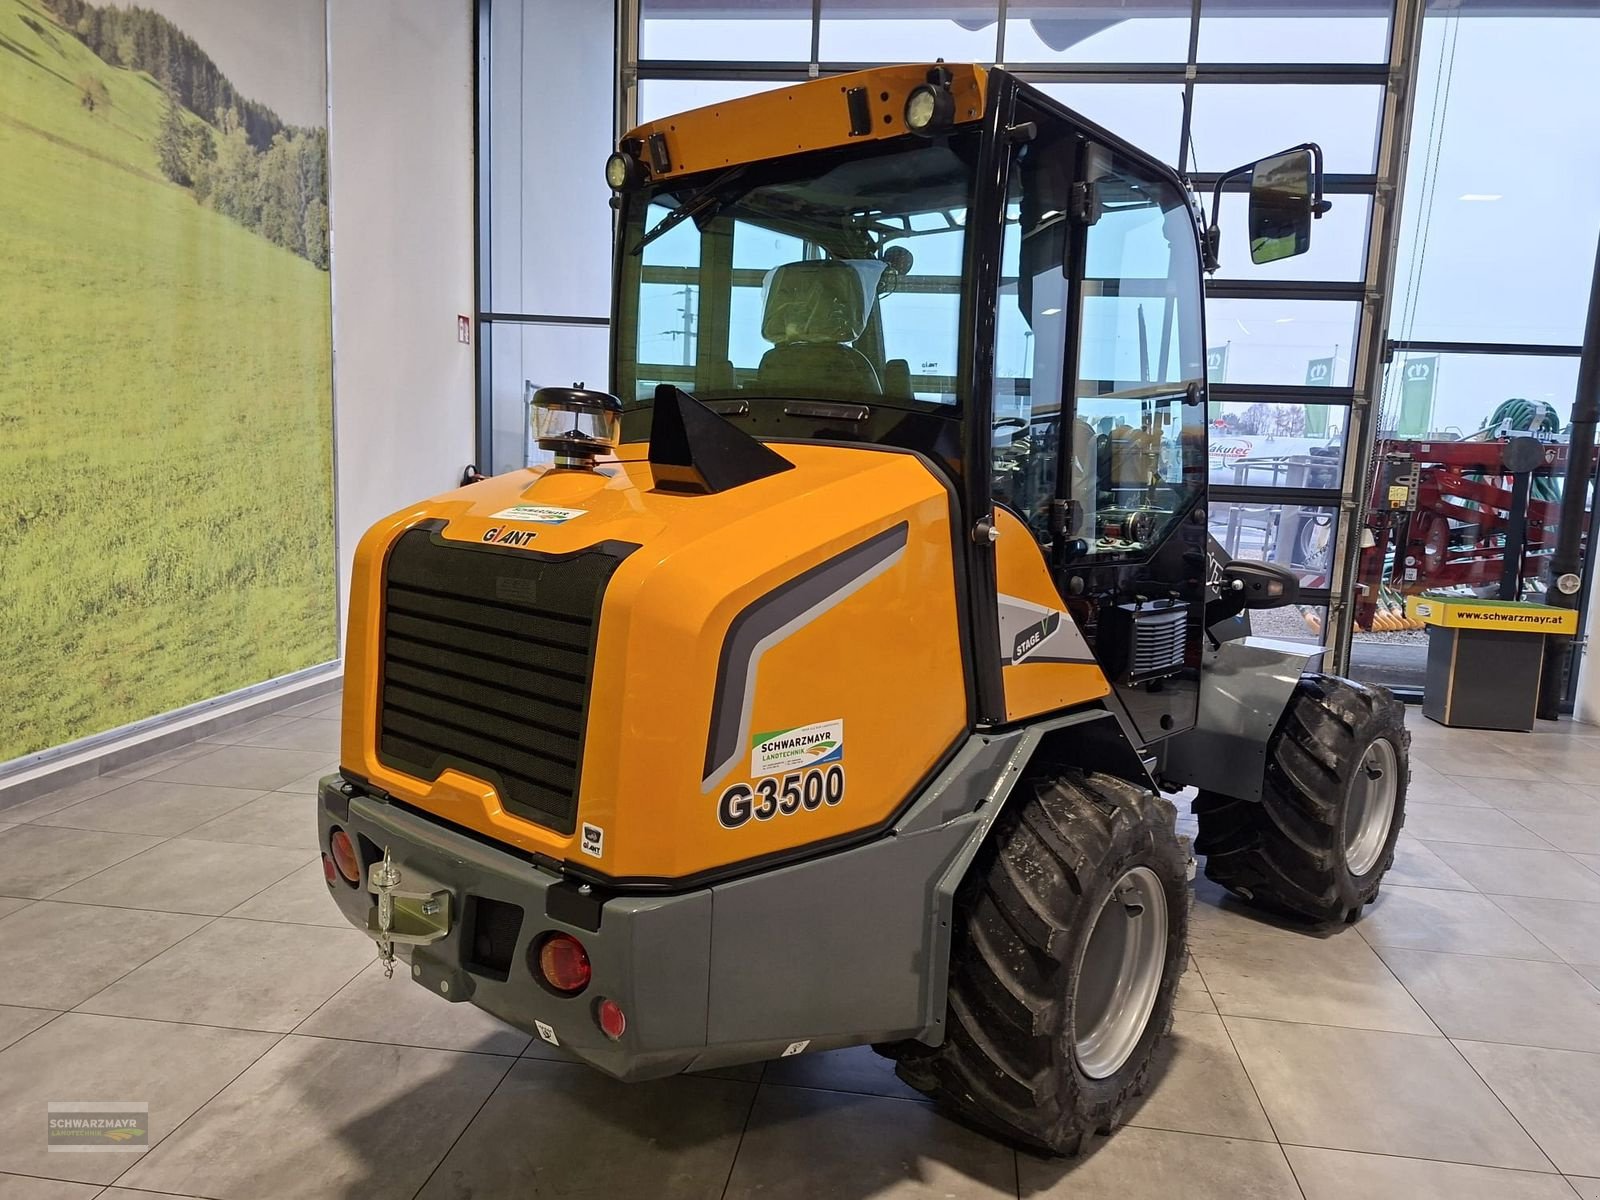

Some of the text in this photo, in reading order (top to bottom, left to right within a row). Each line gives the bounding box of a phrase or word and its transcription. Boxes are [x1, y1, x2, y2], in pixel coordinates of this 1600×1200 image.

[1457, 611, 1563, 624] www.schwarzmayr.at
[1016, 631, 1040, 656] STAGE
[761, 731, 831, 753] SCHWARZMAYR
[762, 748, 805, 762] LANDTECHNIK
[717, 764, 845, 829] G3500
